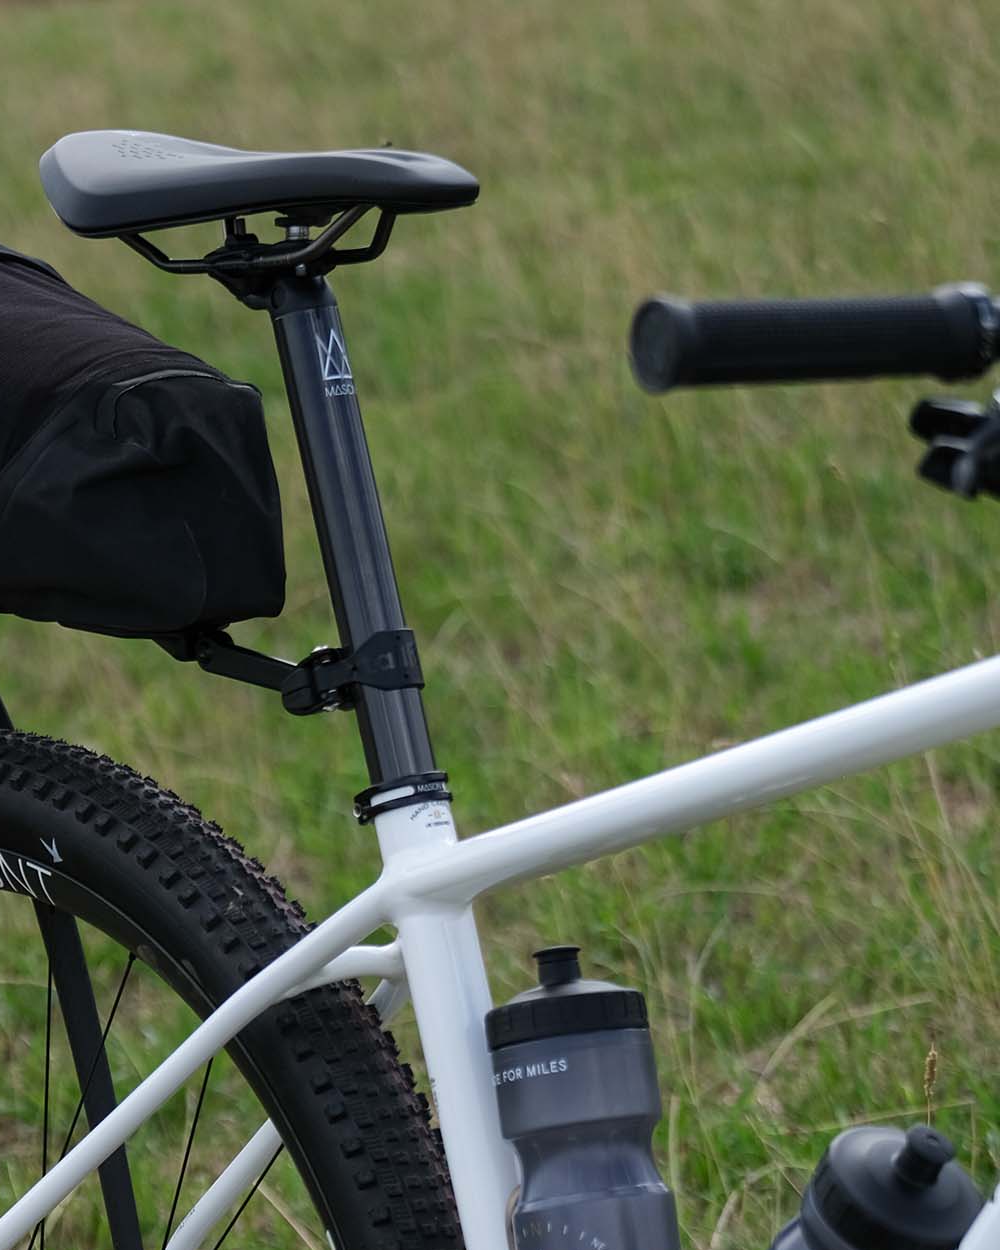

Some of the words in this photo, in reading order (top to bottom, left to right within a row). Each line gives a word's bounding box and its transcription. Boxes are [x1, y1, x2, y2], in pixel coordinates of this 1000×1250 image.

[325, 384, 354, 398] MASO
[502, 1068, 522, 1083] FOR
[526, 1059, 568, 1078] MILES
